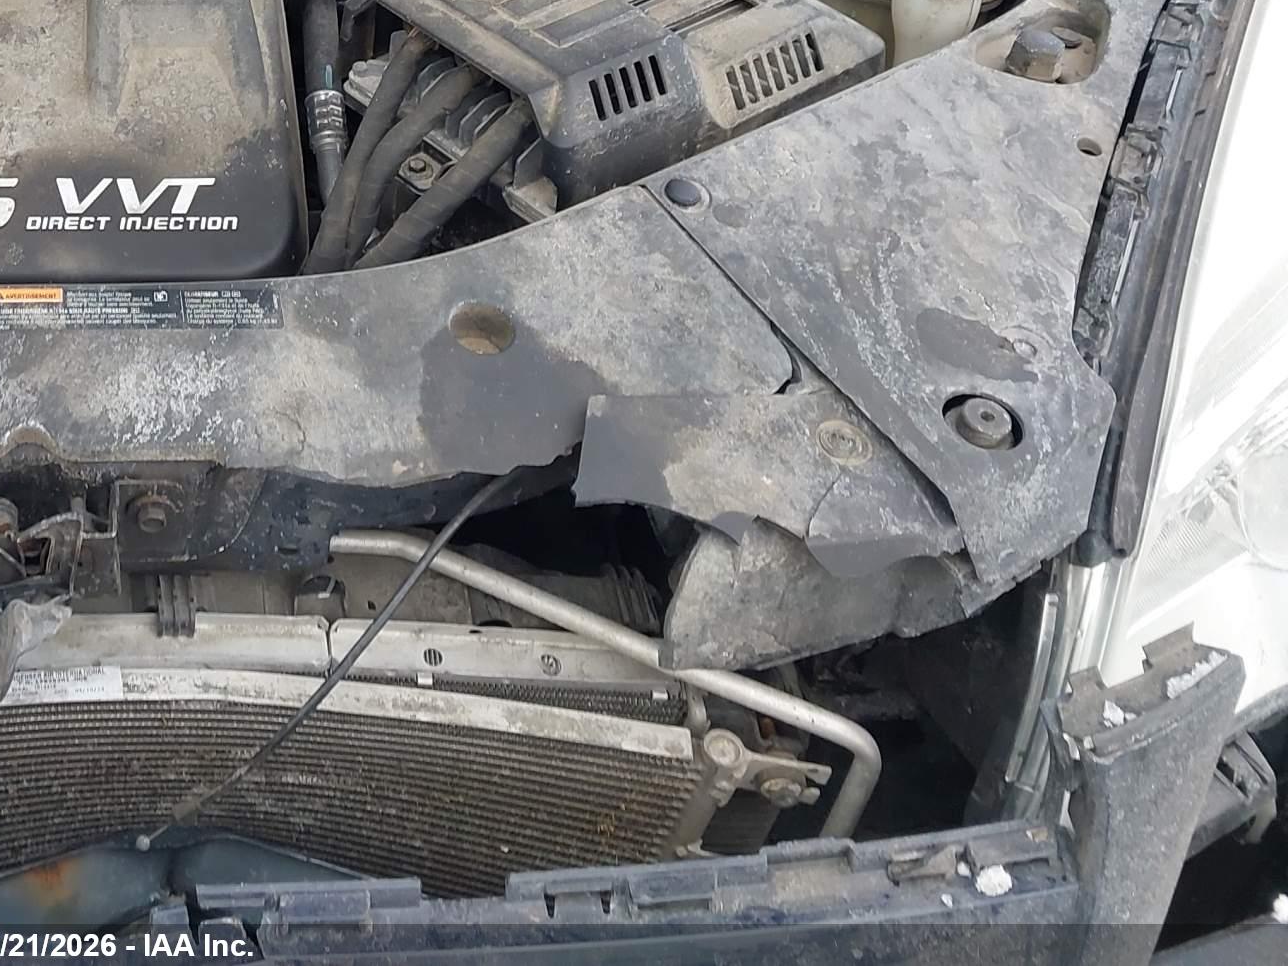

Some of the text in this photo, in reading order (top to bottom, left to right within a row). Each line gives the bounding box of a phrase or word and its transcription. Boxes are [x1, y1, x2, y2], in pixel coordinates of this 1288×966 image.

[55, 177, 216, 214] VVT
[25, 215, 239, 231] DIRECT INJECTION
